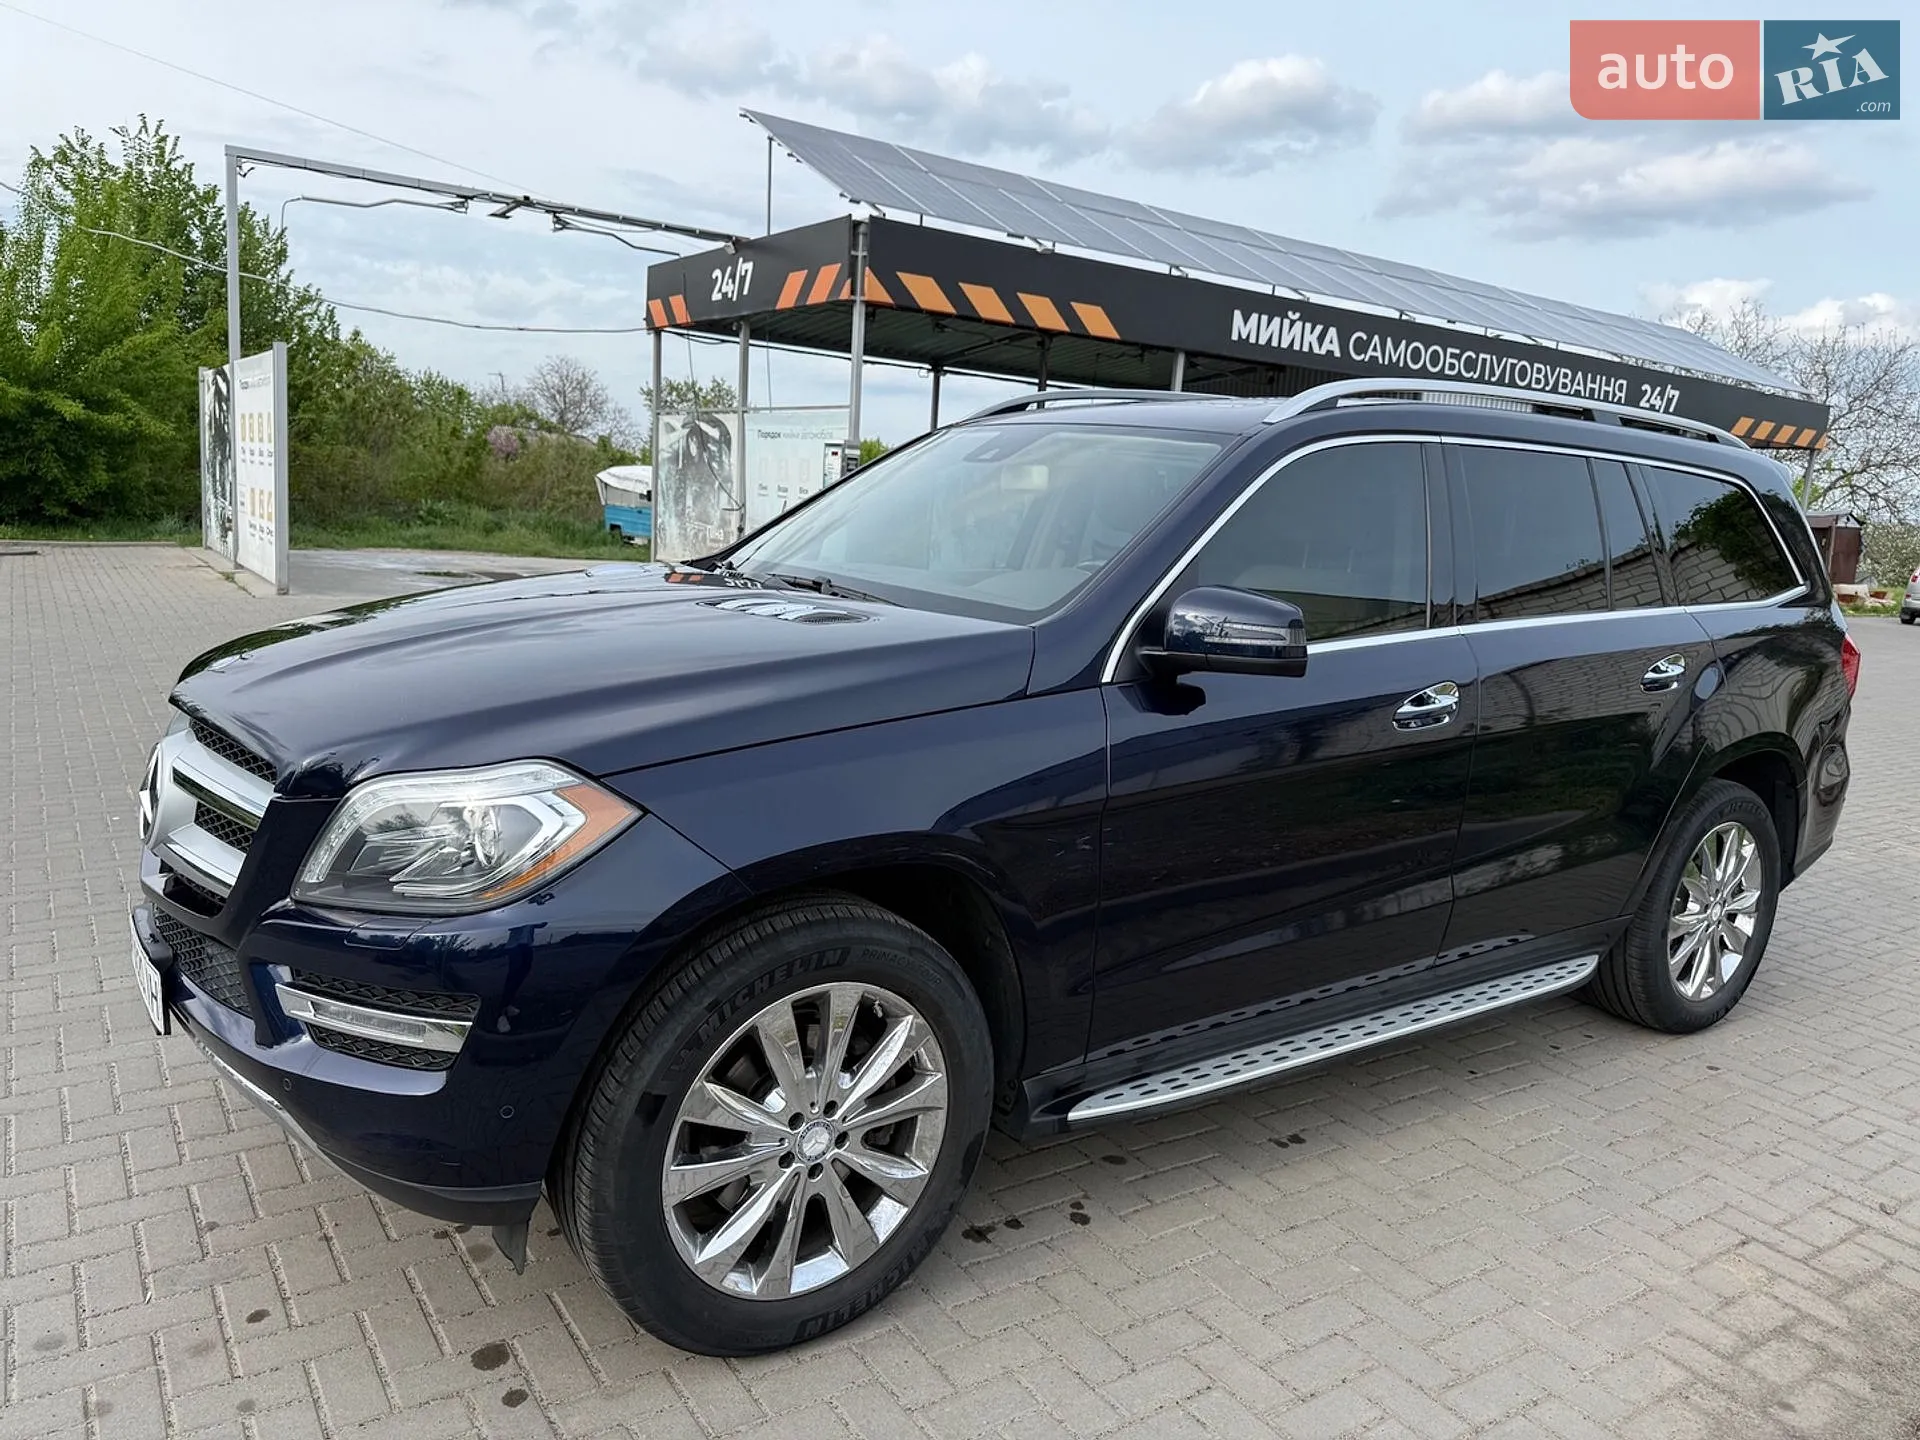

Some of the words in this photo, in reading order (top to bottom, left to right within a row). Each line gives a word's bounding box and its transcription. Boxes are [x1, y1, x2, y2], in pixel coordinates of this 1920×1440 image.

[711, 256, 754, 302] 24/7
[1230, 309, 1342, 358] МИЙКА
[1348, 331, 1628, 405] САМООБСЛУГОВУВАННЯ
[1639, 383, 1681, 414] 24/7
[698, 948, 844, 1041] MICHELIN
